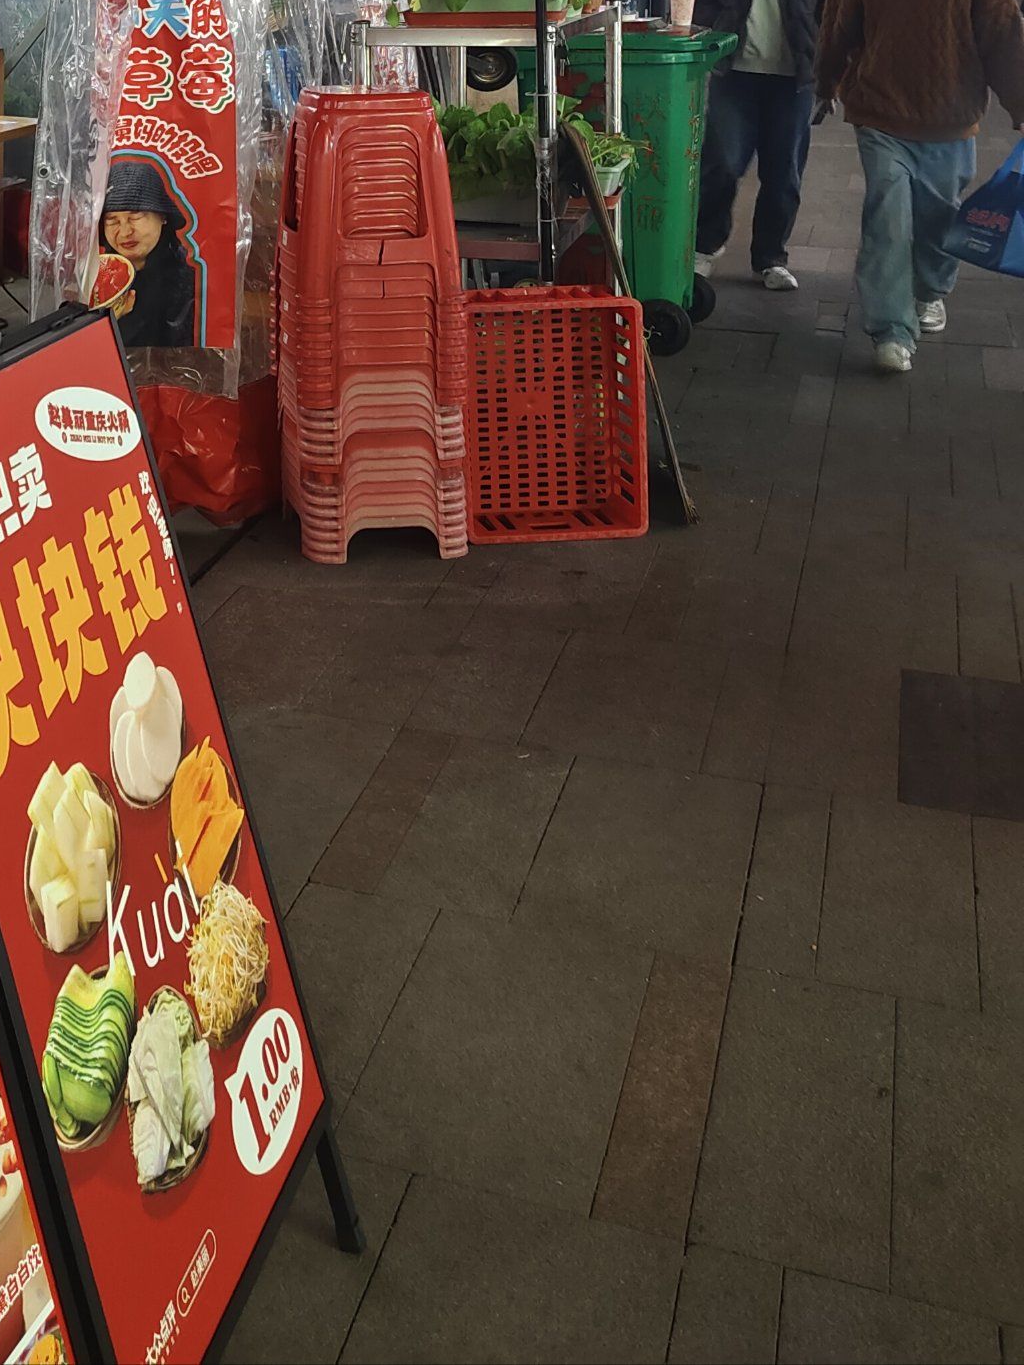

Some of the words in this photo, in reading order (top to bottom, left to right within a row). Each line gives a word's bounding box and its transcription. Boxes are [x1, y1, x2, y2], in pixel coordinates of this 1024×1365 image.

[123, 45, 235, 113] 草莓
[47, 402, 131, 433] 赵美丽重庆火锅
[239, 1017, 290, 1162] 1.00
[145, 1300, 176, 1365] 大众点评
